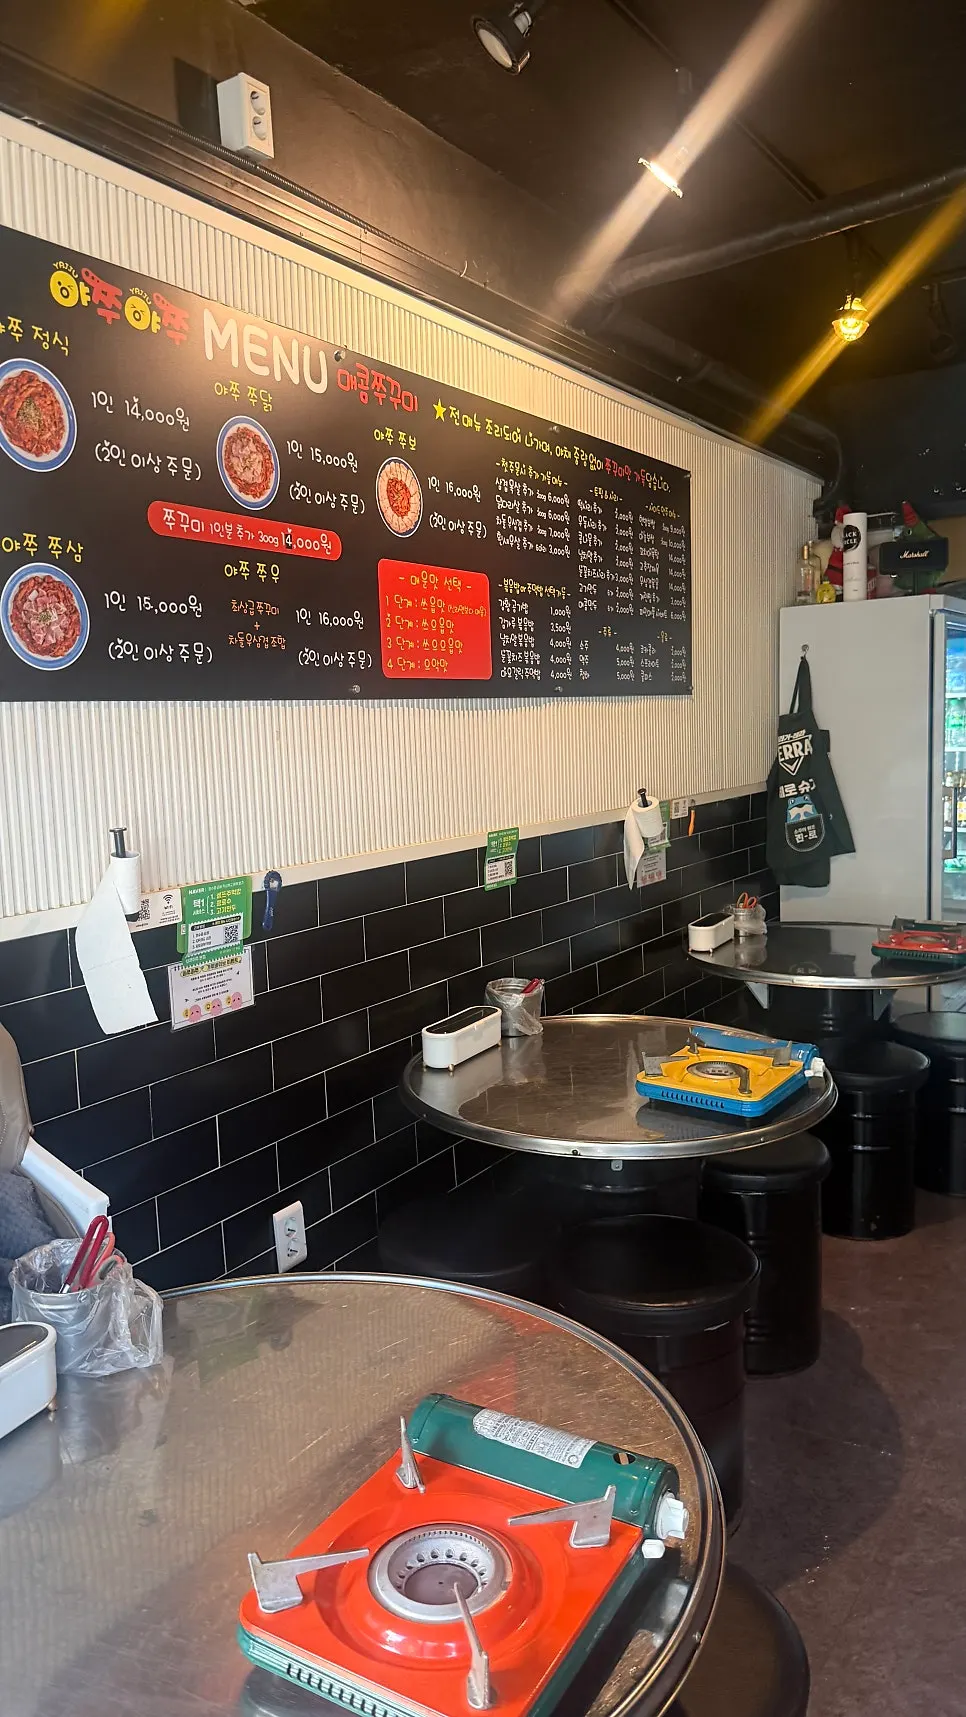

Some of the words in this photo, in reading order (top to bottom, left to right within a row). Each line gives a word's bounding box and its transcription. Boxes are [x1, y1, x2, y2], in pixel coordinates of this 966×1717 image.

[32, 325, 69, 357] 정식
[203, 307, 328, 394] MENU
[214, 380, 240, 402] 야쭈
[248, 386, 273, 413] 쭈닭
[336, 361, 418, 412] 매콤쭈꾸미
[91, 391, 114, 414] 1인
[124, 396, 190, 432] 14,000원
[373, 427, 394, 446] 야쭈
[398, 431, 417, 451] 쭈보
[449, 405, 460, 426] 전
[462, 413, 481, 432] 메뉴
[485, 418, 521, 444] 조리되어
[556, 446, 572, 460] 야채
[95, 440, 125, 468] (2인
[131, 452, 162, 473] 이상
[166, 455, 202, 480] 주문)
[286, 440, 303, 460] 1인
[310, 447, 358, 473] 15,000원
[289, 481, 312, 504] (2인
[314, 489, 336, 510] 이상
[340, 492, 366, 515] 주문)
[427, 475, 440, 492] 1인
[445, 480, 482, 503] 16,000원
[162, 508, 205, 534] 쭈꾸미
[209, 520, 233, 541] 1인분
[236, 524, 255, 544] 추가
[258, 530, 279, 548] 300g
[281, 528, 332, 556] 14,000원
[429, 512, 448, 530] (2인
[449, 517, 466, 534] 이상
[467, 520, 488, 539] 주문)
[1, 533, 38, 556] 야쭈
[47, 536, 84, 562] 쭈삼
[900, 550, 930, 559] Marshall
[224, 560, 250, 580] 야쭈
[256, 563, 280, 584] 쭈우
[444, 576, 462, 592] 선택
[104, 590, 126, 612] 1인
[136, 594, 203, 618] 15,000원
[295, 610, 312, 626] 1인
[318, 610, 364, 630] 16,000원
[108, 637, 139, 662] (2인
[144, 642, 174, 661] 이상
[178, 642, 213, 665] 주문)
[298, 647, 320, 667] (2인
[323, 650, 344, 667] 이상
[347, 650, 372, 669] 주문)
